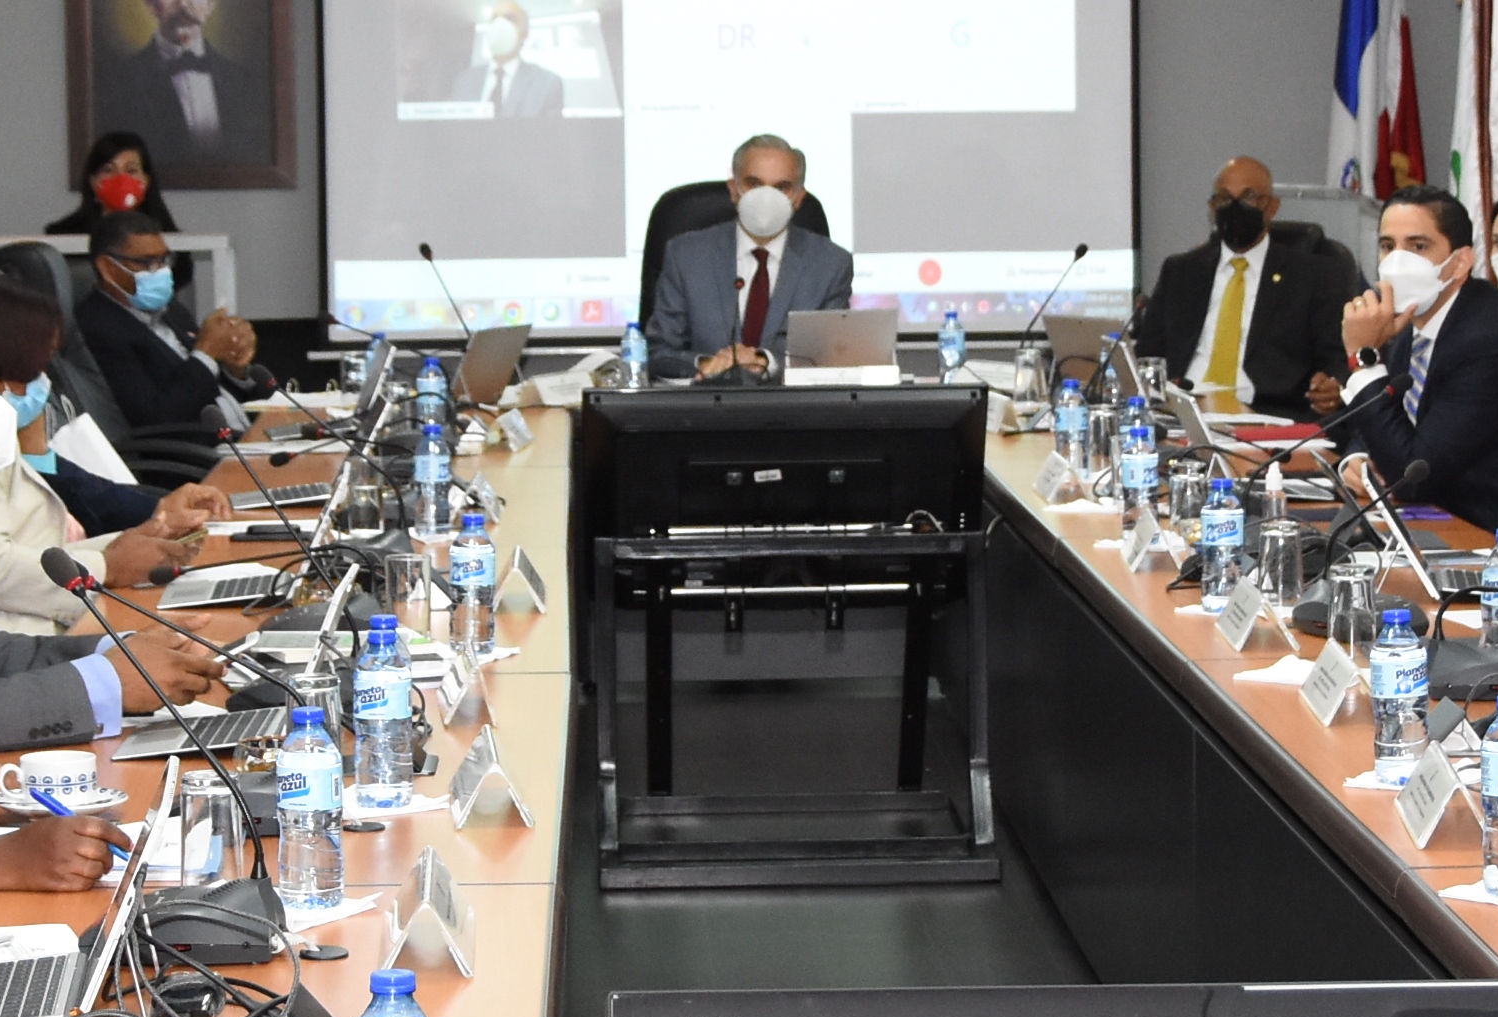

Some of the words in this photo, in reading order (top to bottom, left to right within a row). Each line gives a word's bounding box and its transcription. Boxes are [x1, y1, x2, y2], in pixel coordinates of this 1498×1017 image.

[717, 24, 756, 50] DR
[361, 689, 385, 703] azul
[281, 776, 306, 791] azul
